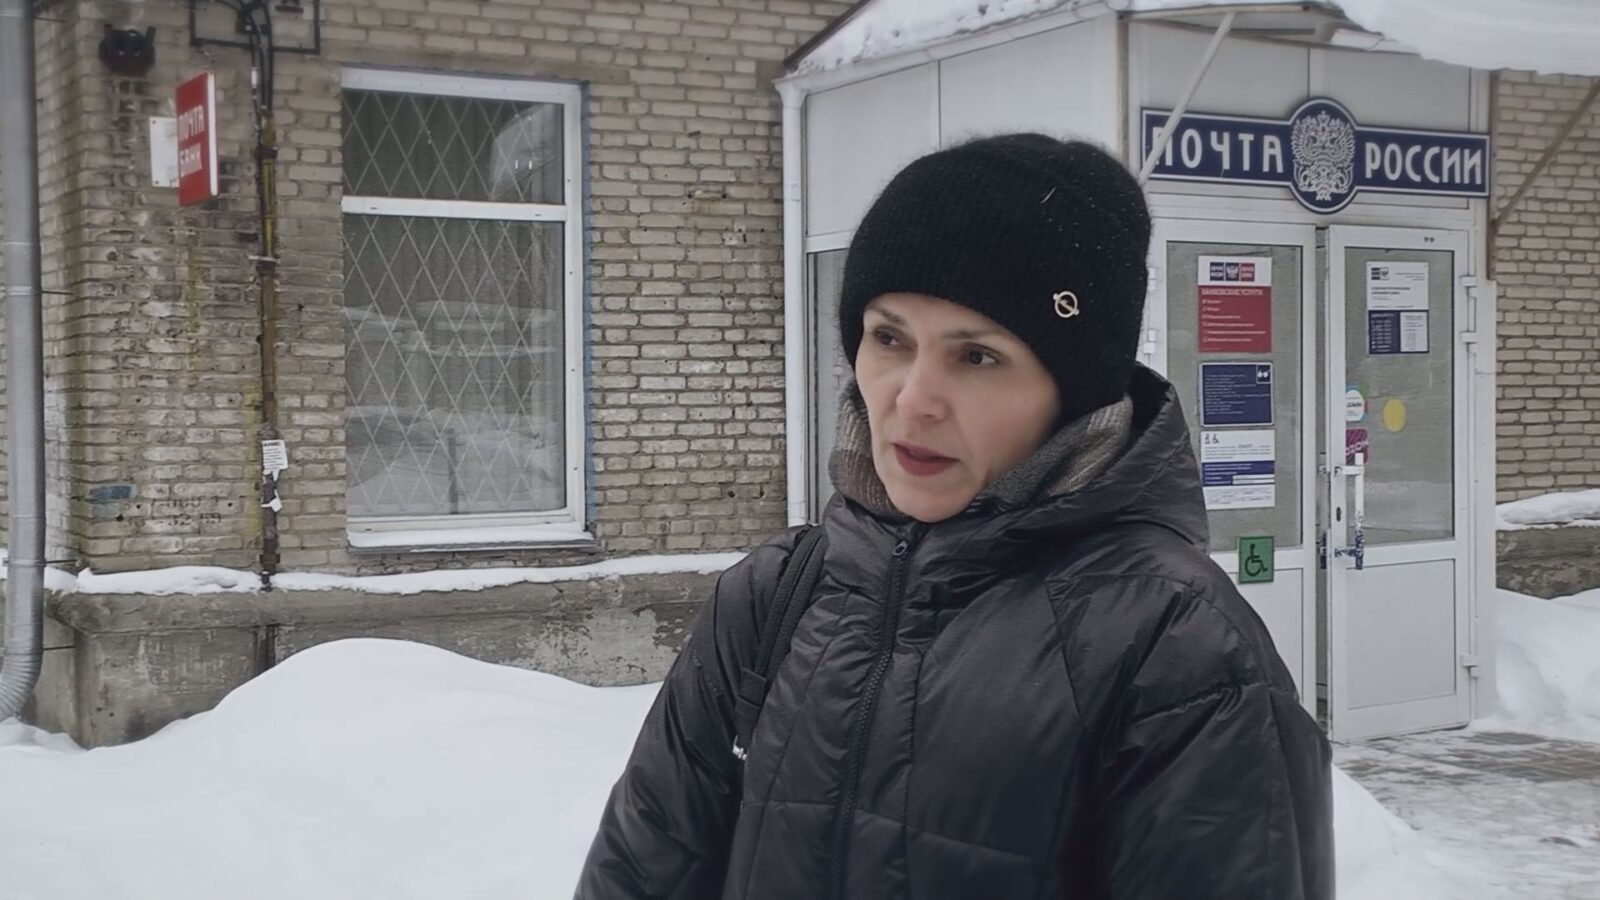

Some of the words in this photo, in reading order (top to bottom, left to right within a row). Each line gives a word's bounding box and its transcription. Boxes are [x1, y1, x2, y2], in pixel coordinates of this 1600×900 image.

[179, 104, 205, 142] ПОЧТА
[179, 142, 203, 178] БАНК
[1151, 126, 1284, 174] ПОЧТА
[1364, 141, 1483, 186] РОССИИ
